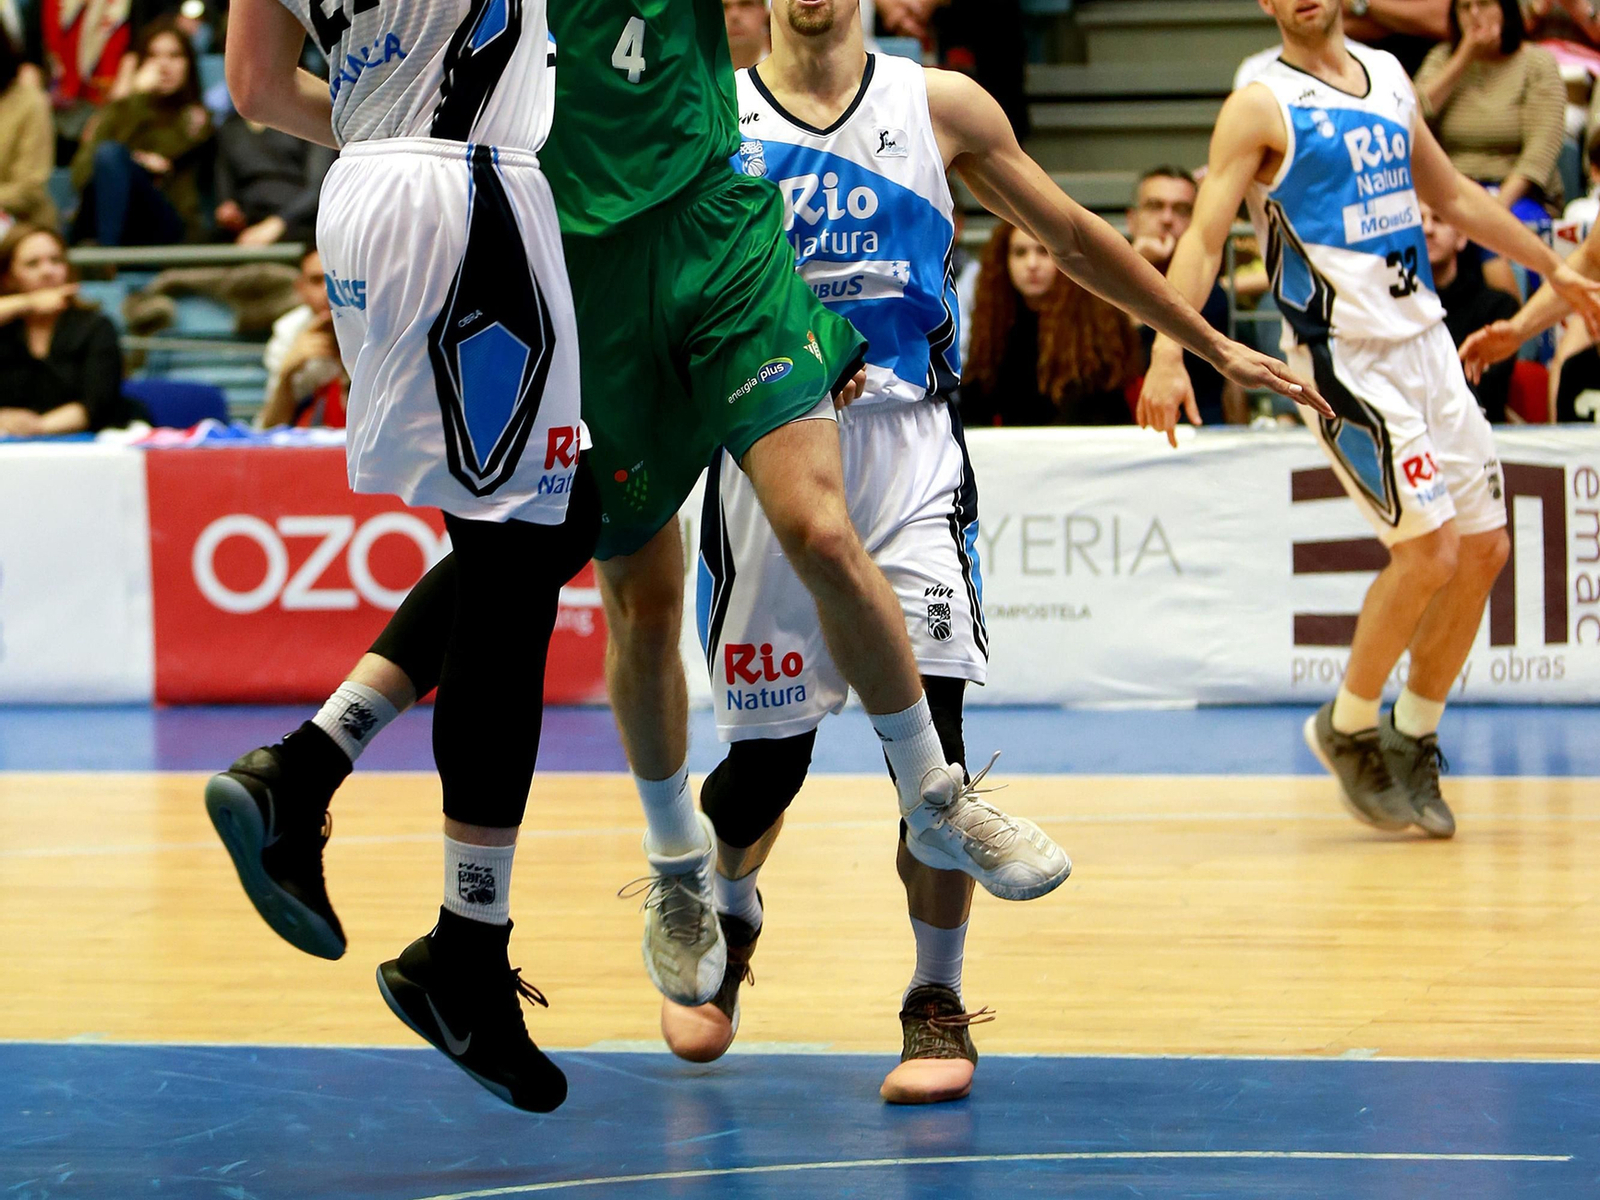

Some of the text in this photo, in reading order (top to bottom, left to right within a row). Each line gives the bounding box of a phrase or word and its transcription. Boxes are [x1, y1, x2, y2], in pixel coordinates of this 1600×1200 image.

[611, 15, 646, 84] 4
[1343, 123, 1406, 173] Rio
[778, 171, 879, 231] Rio
[760, 363, 784, 382] plus
[544, 425, 581, 470] Ri
[538, 475, 574, 494] Nat
[1402, 451, 1439, 488] Ri
[981, 513, 1183, 577] YERIA
[984, 603, 1092, 620] OMPOSTELA
[724, 643, 804, 685] Rio
[1489, 651, 1567, 683] obras
[727, 684, 806, 710] Natura
